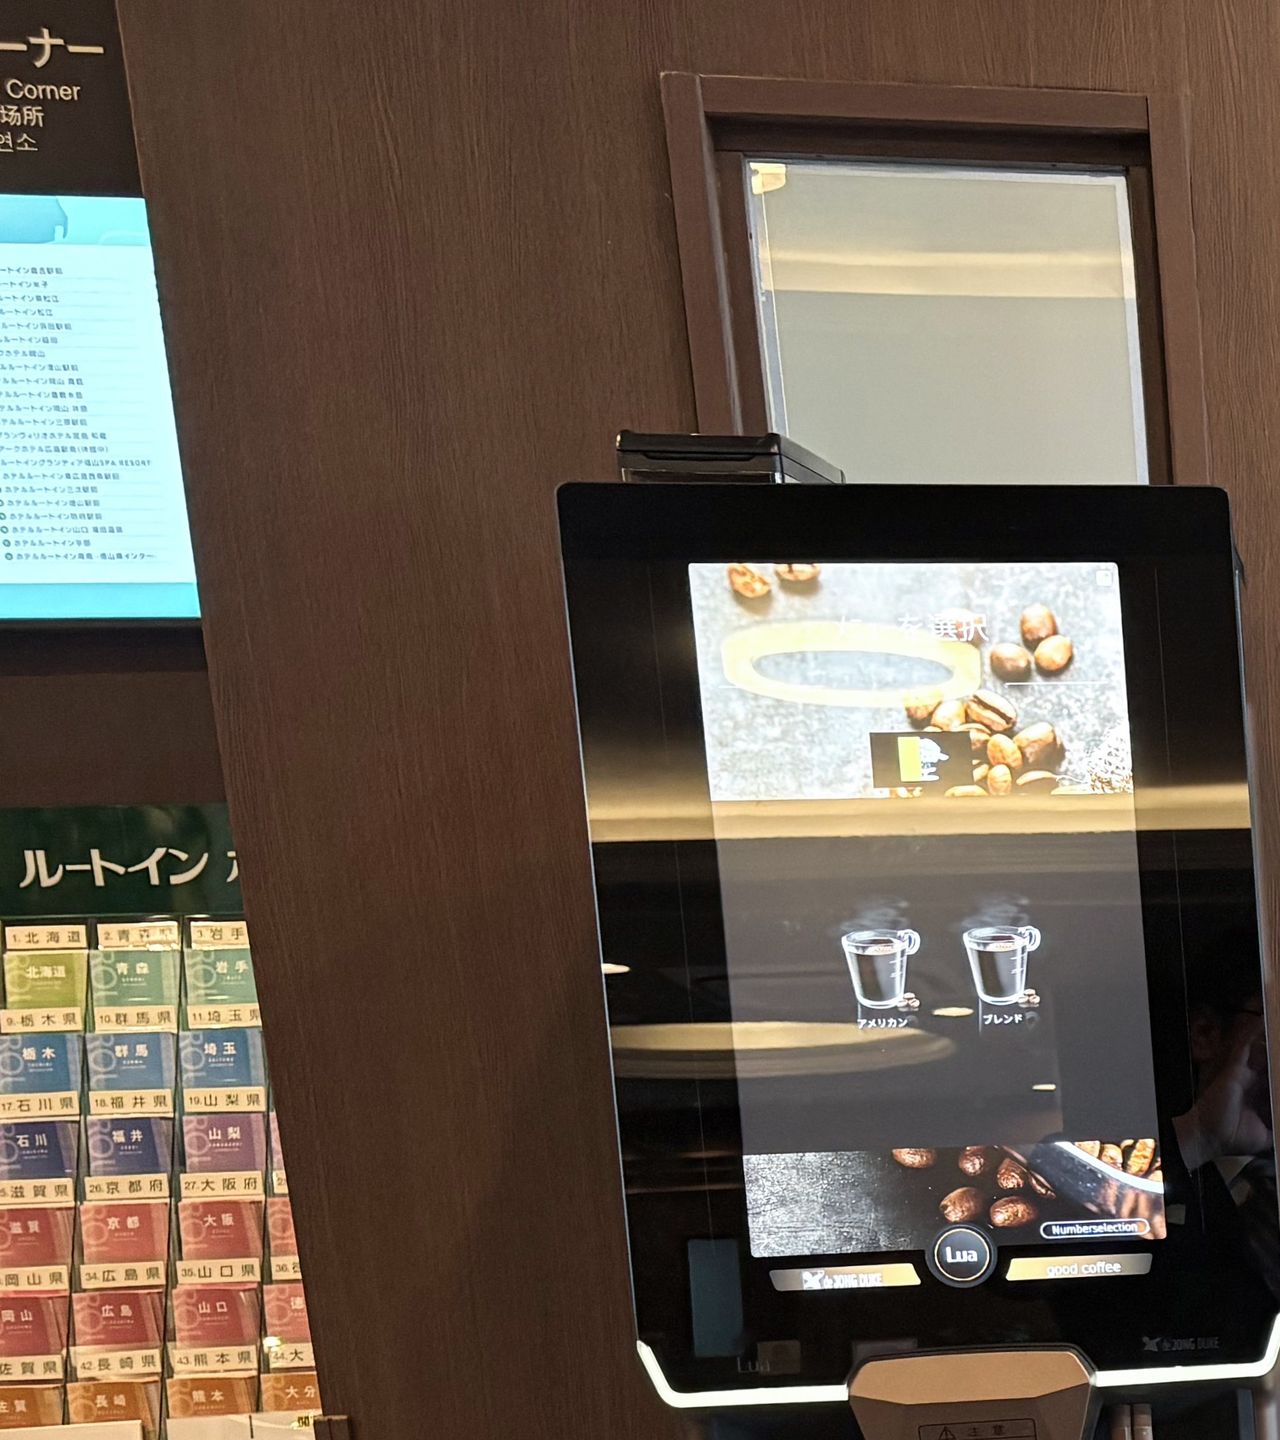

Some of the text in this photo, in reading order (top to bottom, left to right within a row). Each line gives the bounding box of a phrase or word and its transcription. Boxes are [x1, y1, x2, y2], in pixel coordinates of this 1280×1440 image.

[6, 78, 81, 101] Corner
[20, 847, 208, 888] ルートイン
[25, 964, 66, 979] 北海道
[857, 1017, 908, 1030] アメリカン
[982, 1013, 1023, 1026] ブレンド
[114, 1044, 148, 1058] 群馬
[16, 1133, 48, 1147] 石川
[112, 1129, 144, 1143] 福井
[208, 1126, 241, 1140] 山梨
[106, 1215, 140, 1230] 京都
[203, 1212, 235, 1227] 大阪
[1051, 1220, 1139, 1235] Numberselection
[945, 1246, 979, 1264] Lua
[1046, 1260, 1122, 1278] good coffee
[101, 1303, 133, 1318] 広島
[199, 1300, 228, 1315] 山口
[2, 1308, 33, 1323] 岡山
